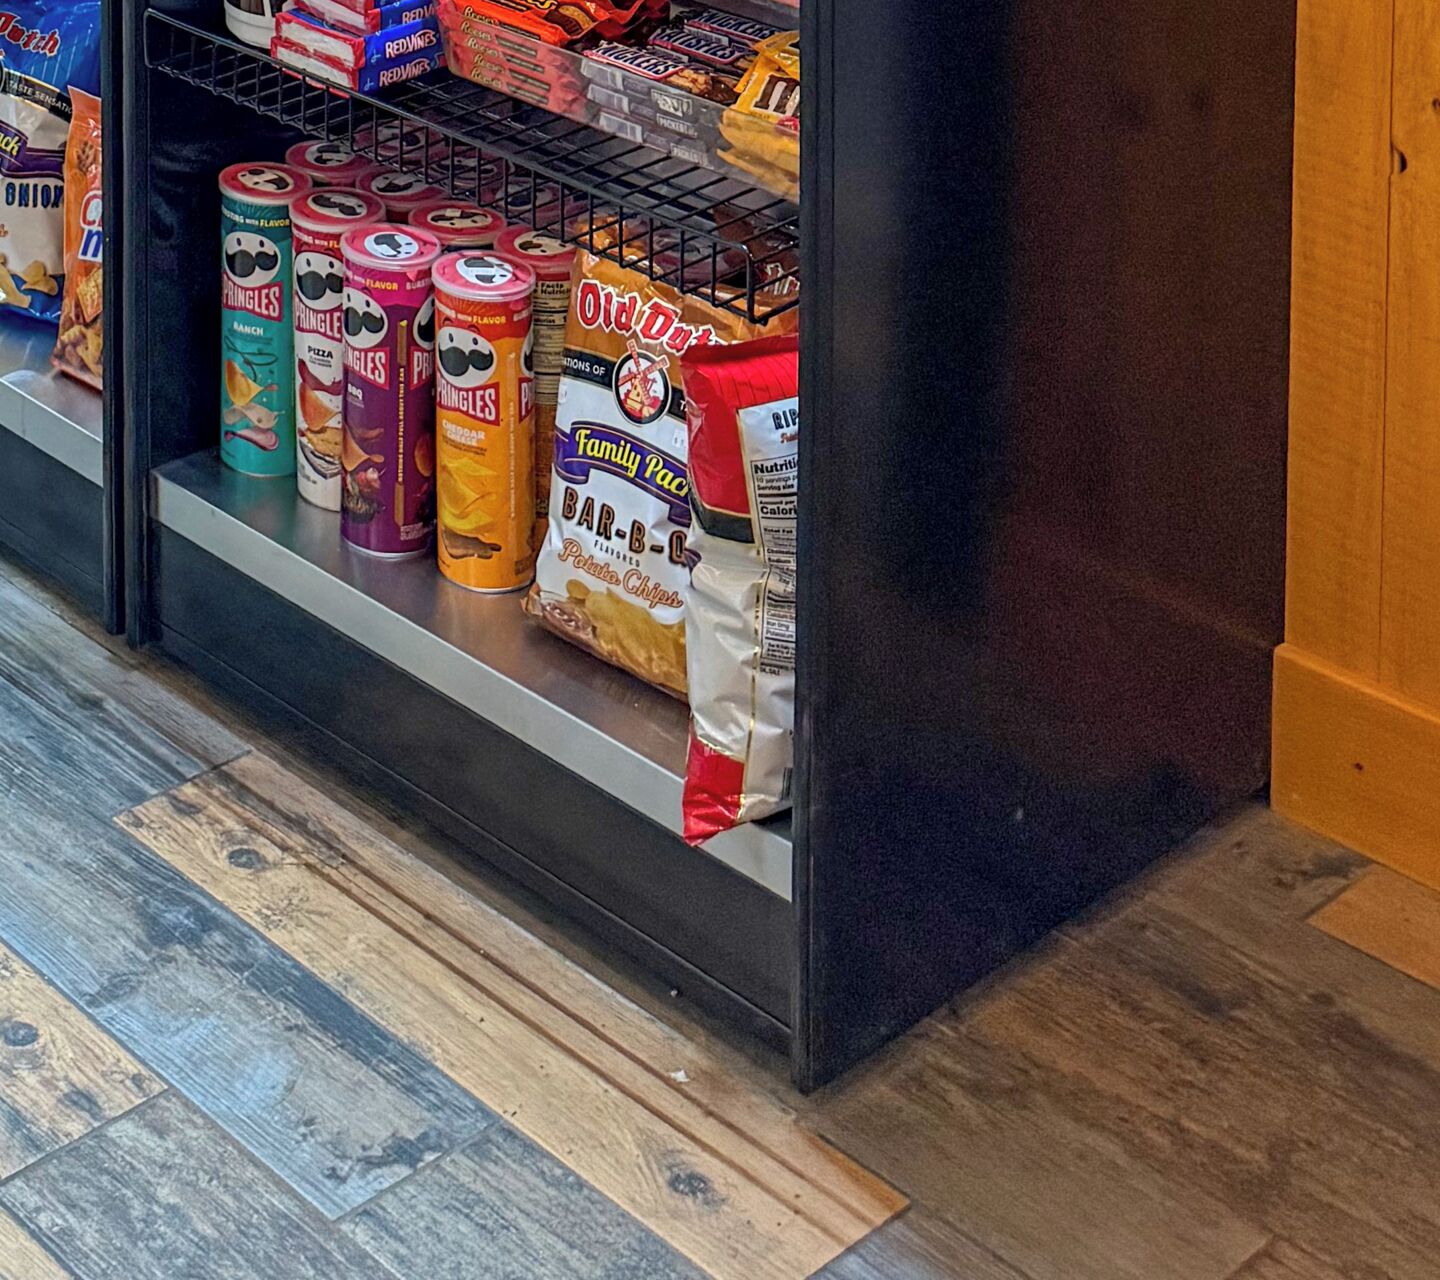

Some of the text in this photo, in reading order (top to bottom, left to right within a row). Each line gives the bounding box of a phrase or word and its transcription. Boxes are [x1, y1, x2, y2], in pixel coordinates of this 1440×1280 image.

[9, 78, 34, 97] TASTE
[259, 218, 290, 228] FLAVOR
[222, 275, 280, 319] PRINGLES
[366, 278, 399, 291] FLAVOR
[232, 321, 264, 337] RANCH
[294, 293, 343, 339] PRINGLE
[472, 314, 507, 326] FLAVOR
[578, 281, 713, 353] Old Dut
[307, 345, 334, 360] PIZZA
[344, 347, 386, 385] INGLES
[592, 363, 607, 376] OF
[436, 379, 497, 423] PRINGLES
[441, 418, 486, 441] CHEDDAR
[575, 428, 641, 480] Family
[593, 539, 641, 568] FLAVORED
[558, 536, 684, 609] Potato Chips
